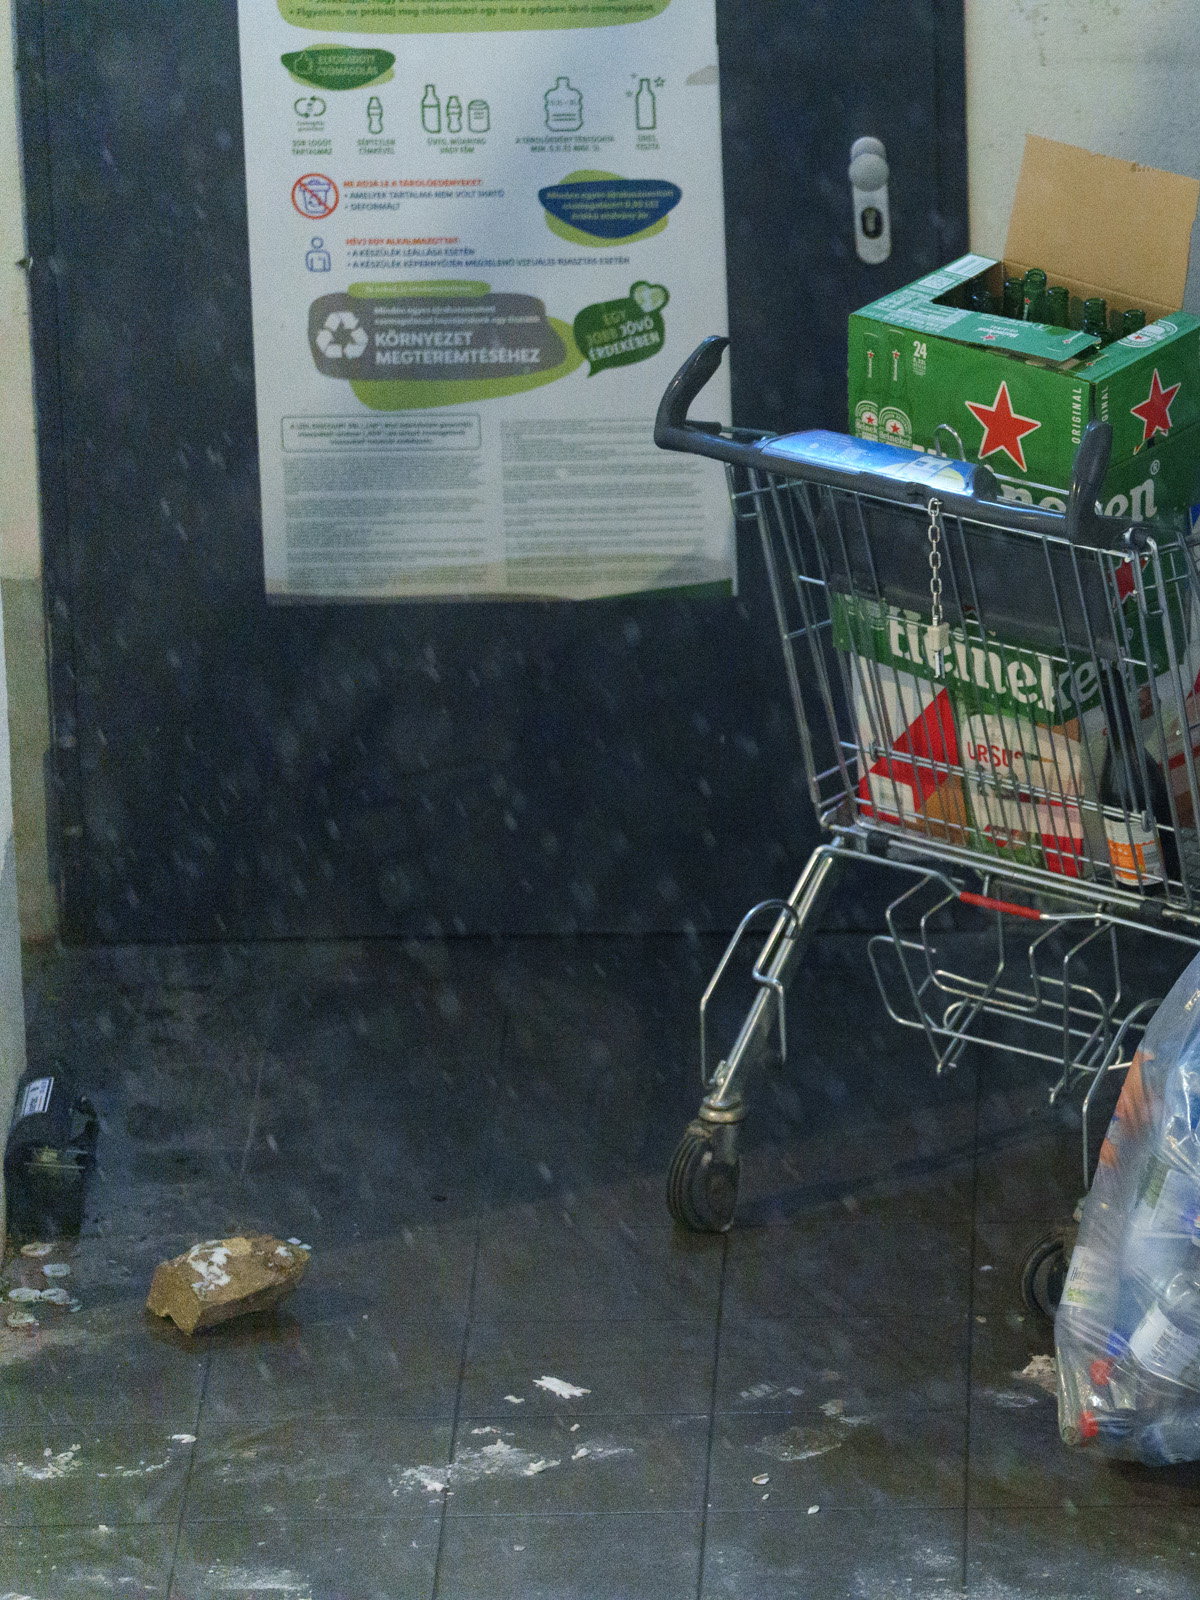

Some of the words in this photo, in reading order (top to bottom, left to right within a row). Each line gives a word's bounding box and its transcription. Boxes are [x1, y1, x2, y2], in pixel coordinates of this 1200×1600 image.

[375, 329, 473, 347] KÖRNYEZET
[376, 347, 541, 365] MEGTEREMTÉSÉHEZ
[913, 341, 928, 359] 24
[1101, 385, 1109, 422] GINAL
[1072, 388, 1082, 444] ORIGINAL
